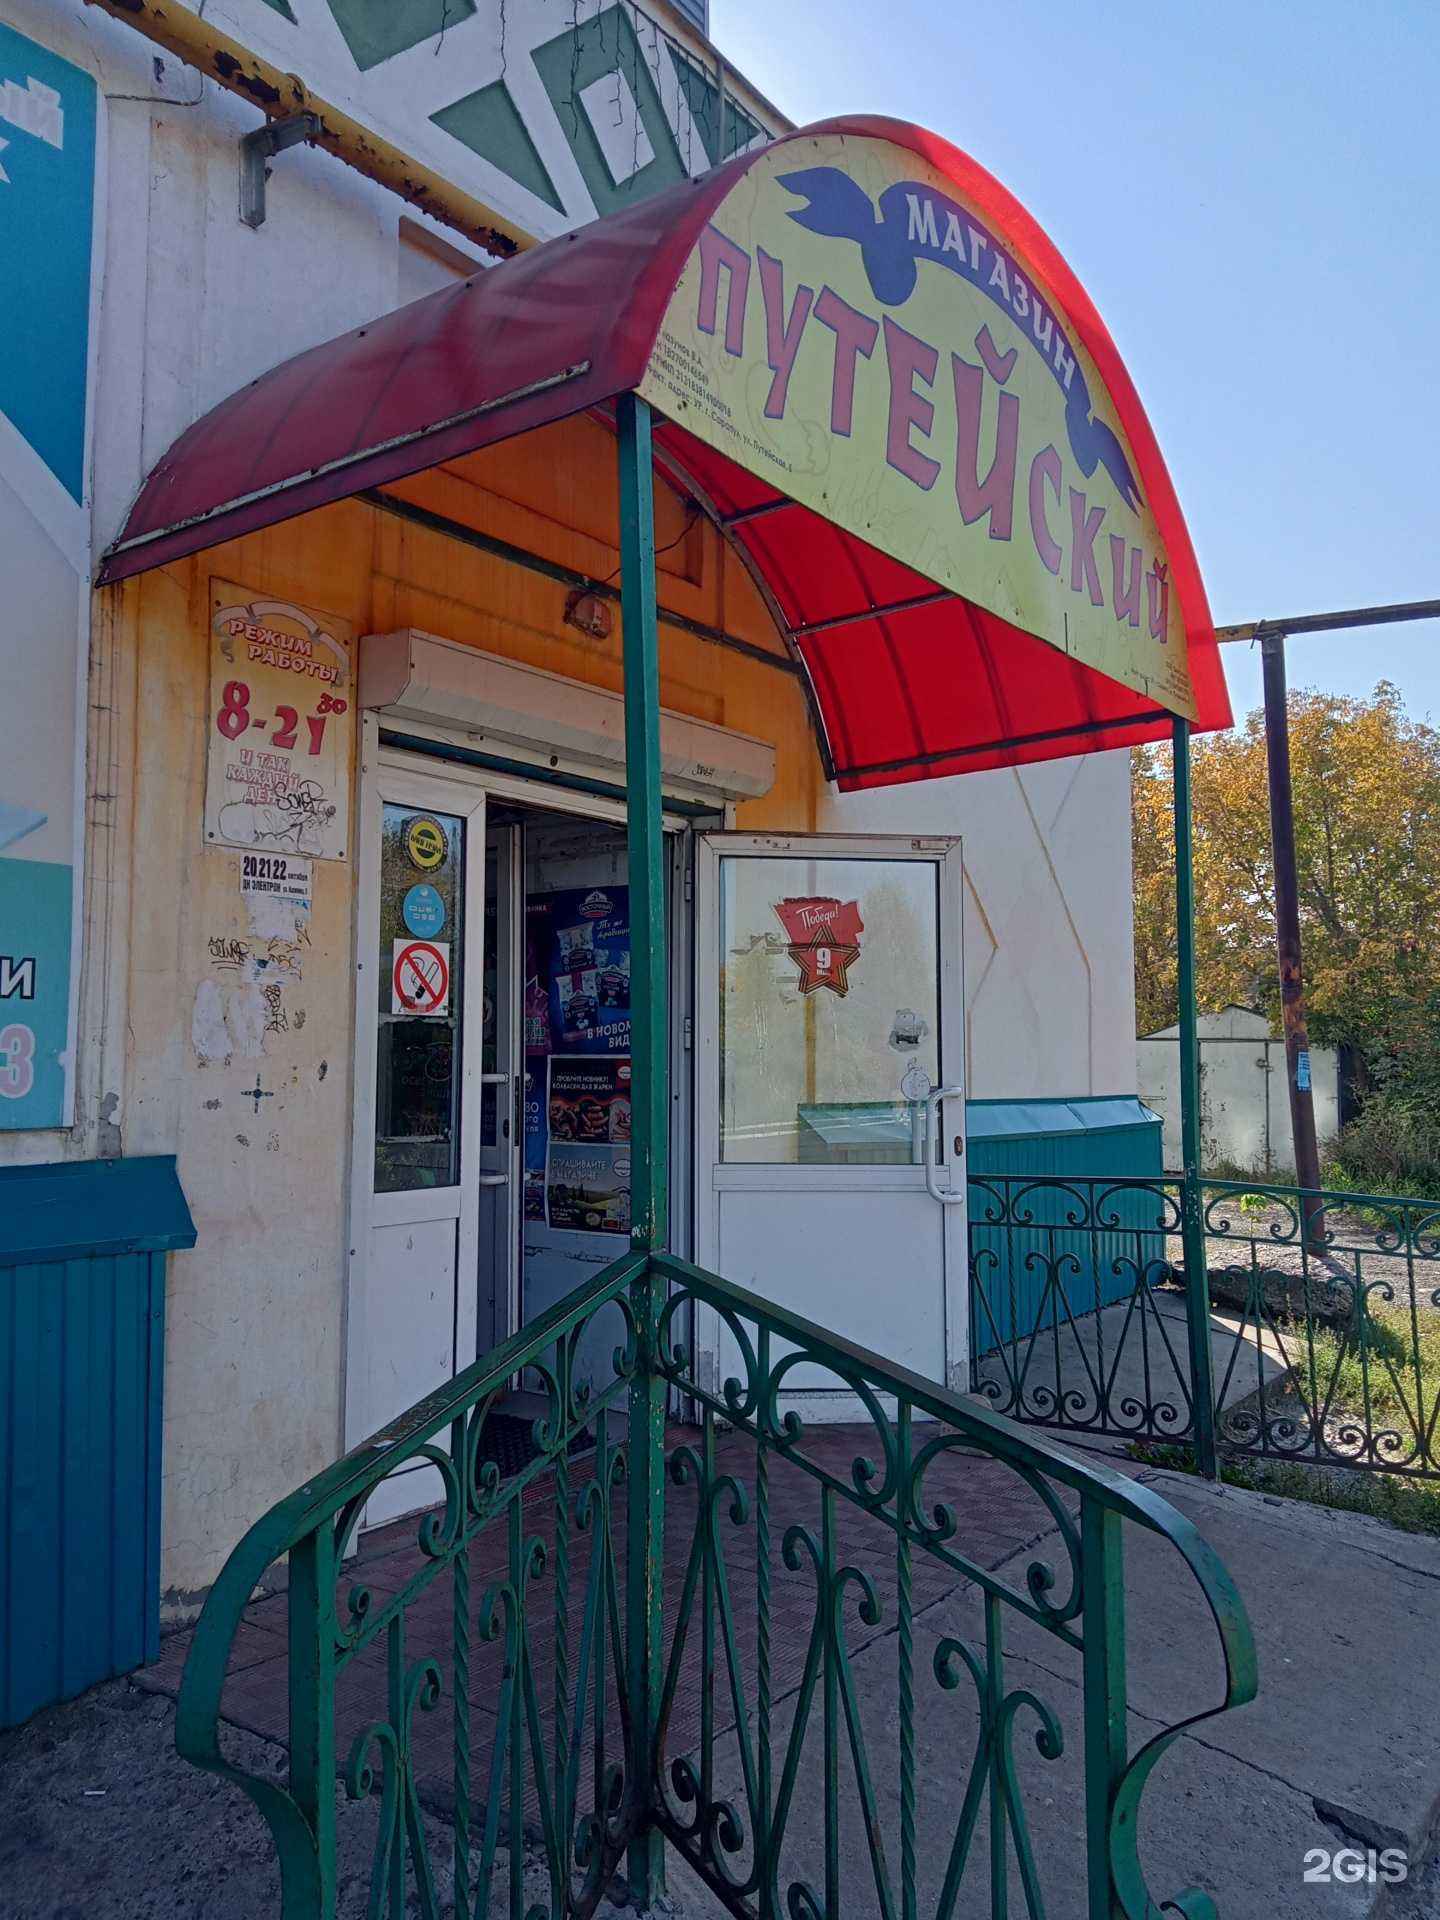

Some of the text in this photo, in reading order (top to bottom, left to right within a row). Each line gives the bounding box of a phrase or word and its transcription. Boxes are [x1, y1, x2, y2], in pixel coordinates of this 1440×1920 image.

[905, 193, 1076, 389] МАГАЗИН
[697, 223, 1169, 644] ПУТЕЙСКИЙ
[228, 619, 313, 657] РЕЖИМ
[248, 643, 341, 683] РАБОТЫ
[256, 752, 290, 774] ТАК
[796, 904, 840, 929] Победа!
[816, 948, 832, 969] 9
